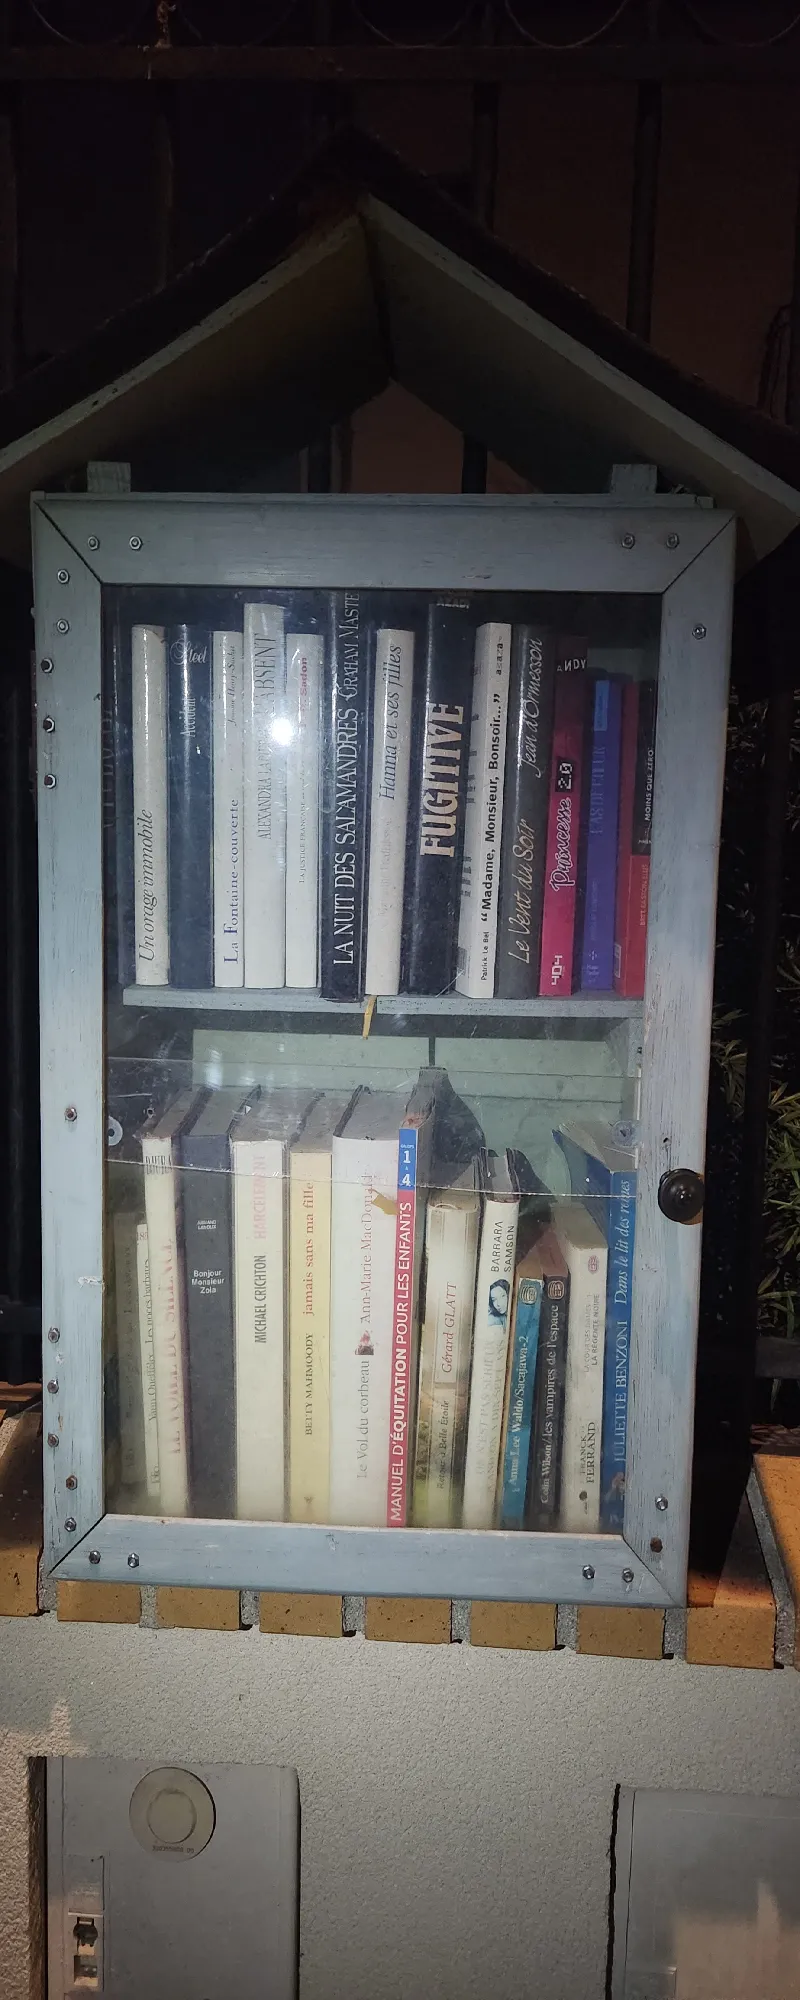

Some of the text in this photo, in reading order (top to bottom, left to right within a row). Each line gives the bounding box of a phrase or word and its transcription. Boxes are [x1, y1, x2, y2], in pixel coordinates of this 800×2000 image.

[170, 638, 208, 666] Steel
[338, 644, 359, 698] GRAHAM
[179, 697, 196, 737] Accident
[379, 645, 403, 799] Hanna et ses filles
[519, 637, 543, 778] Jean d'Ormesson
[419, 702, 464, 858] FUGITIVE
[257, 778, 272, 839] ALEXANDRA
[484, 776, 499, 843] Monsieur,
[549, 762, 575, 892] Princesse 2.0
[644, 793, 652, 821] MOINS
[333, 708, 358, 964] LA NUIT DES SALAMANDRES
[137, 810, 157, 961] Un orage immobile
[223, 800, 238, 964] La Fontaine-couverte
[508, 818, 535, 964] Le Vent du Soir
[480, 957, 488, 980] Patrick
[551, 955, 563, 985] 404
[402, 1174, 411, 1187] 4
[403, 1150, 411, 1163] 1
[302, 1182, 315, 1316] jamais sans ma fille
[359, 1174, 374, 1324] Ann-Marie MacDonald
[491, 1221, 503, 1272] BARBARA
[504, 1225, 514, 1272] SAMSON
[614, 1240, 629, 1253] lit
[615, 1217, 630, 1236] des
[192, 1278, 224, 1286] Monsieur
[194, 1270, 222, 1278] Bonjour
[614, 1255, 628, 1267] le
[254, 1255, 267, 1343] MICHAEL CRICHTON
[614, 1270, 628, 1304] Dans
[441, 1281, 456, 1373] Gérard GLATT
[546, 1305, 559, 1347] l'espace
[390, 1202, 411, 1521] MANUEL D'ÉQUITATION POUR LES ENFANTS
[546, 1351, 556, 1365] de
[591, 1356, 597, 1365] LA
[304, 1333, 313, 1436] BETTY MAHMOODY
[544, 1369, 557, 1418] vampires
[612, 1320, 628, 1462] JULIETTE BENZONI
[357, 1360, 370, 1478] Le Vol du corbeau
[438, 1400, 450, 1425] Étoile
[439, 1428, 448, 1448] Belle
[586, 1422, 595, 1483] FERRAND
[540, 1478, 550, 1504] Colin
